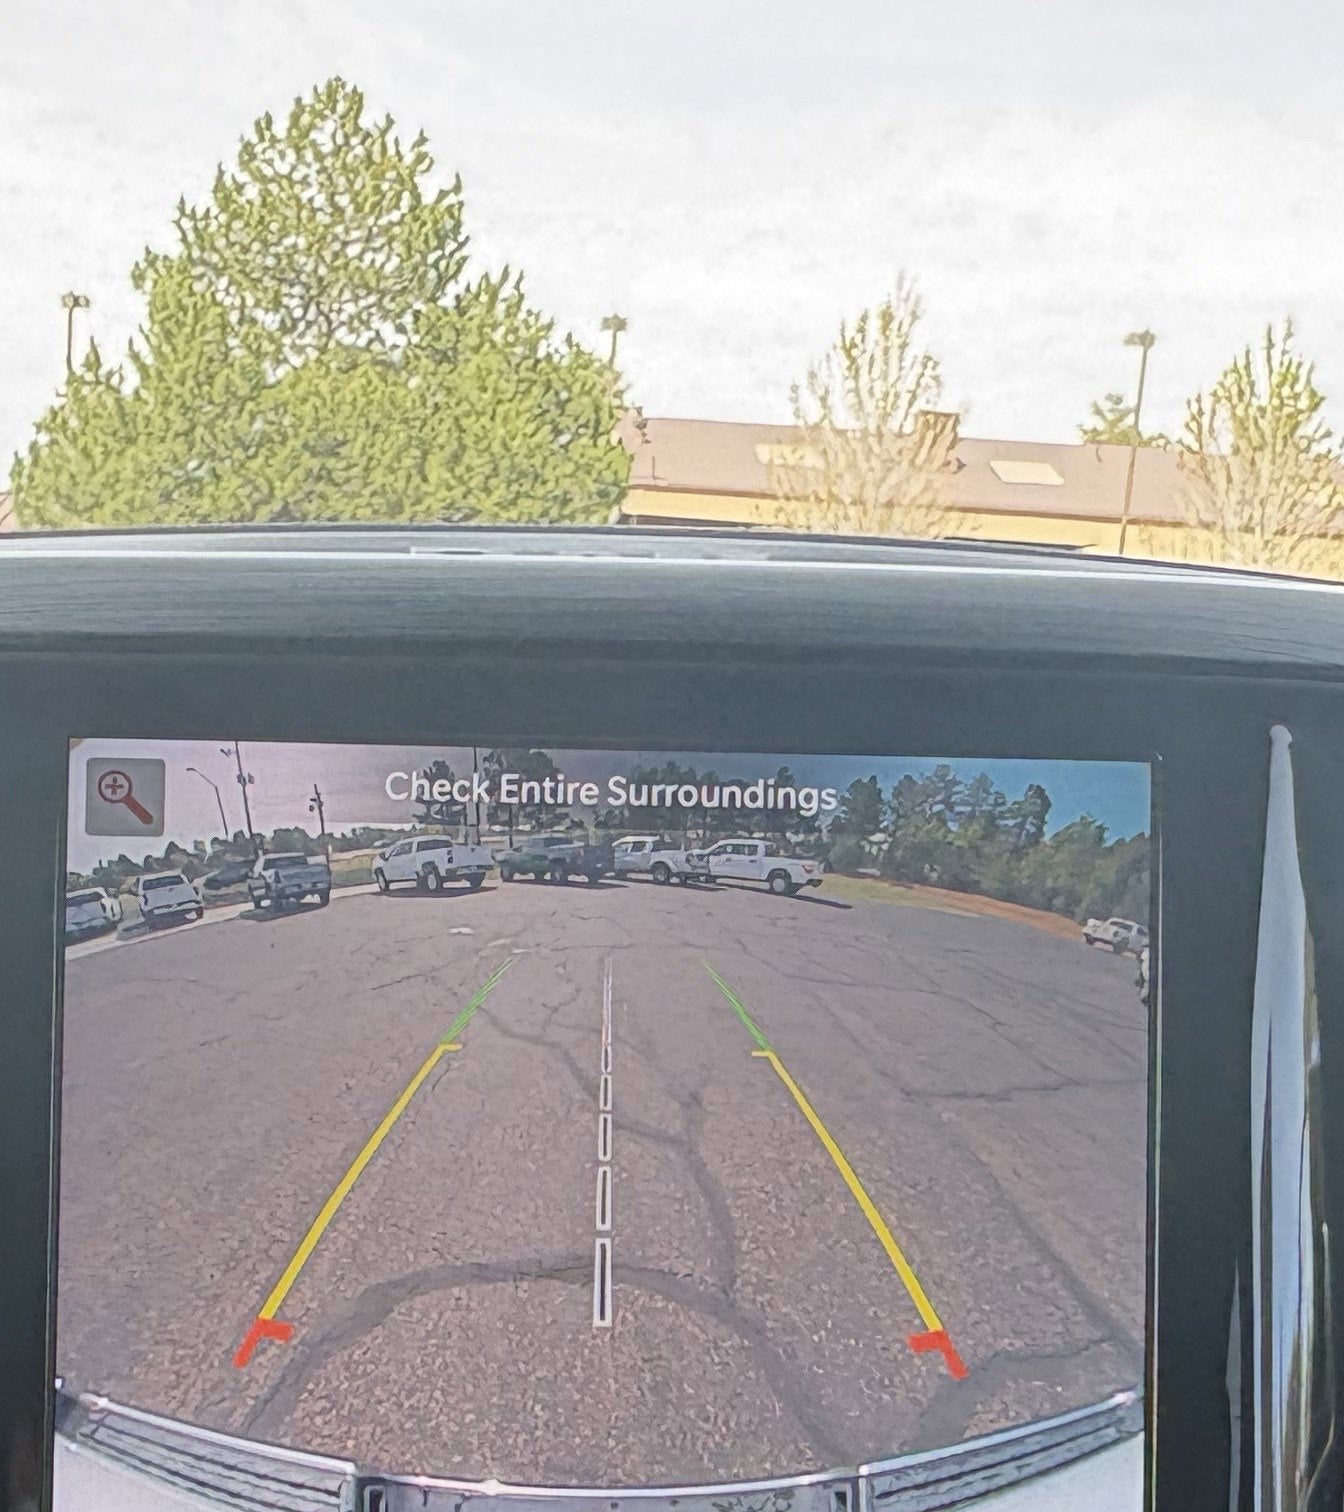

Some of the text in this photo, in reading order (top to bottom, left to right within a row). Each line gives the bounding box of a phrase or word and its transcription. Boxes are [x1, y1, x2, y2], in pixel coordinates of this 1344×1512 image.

[385, 771, 838, 817] Check Entire Surroundings
